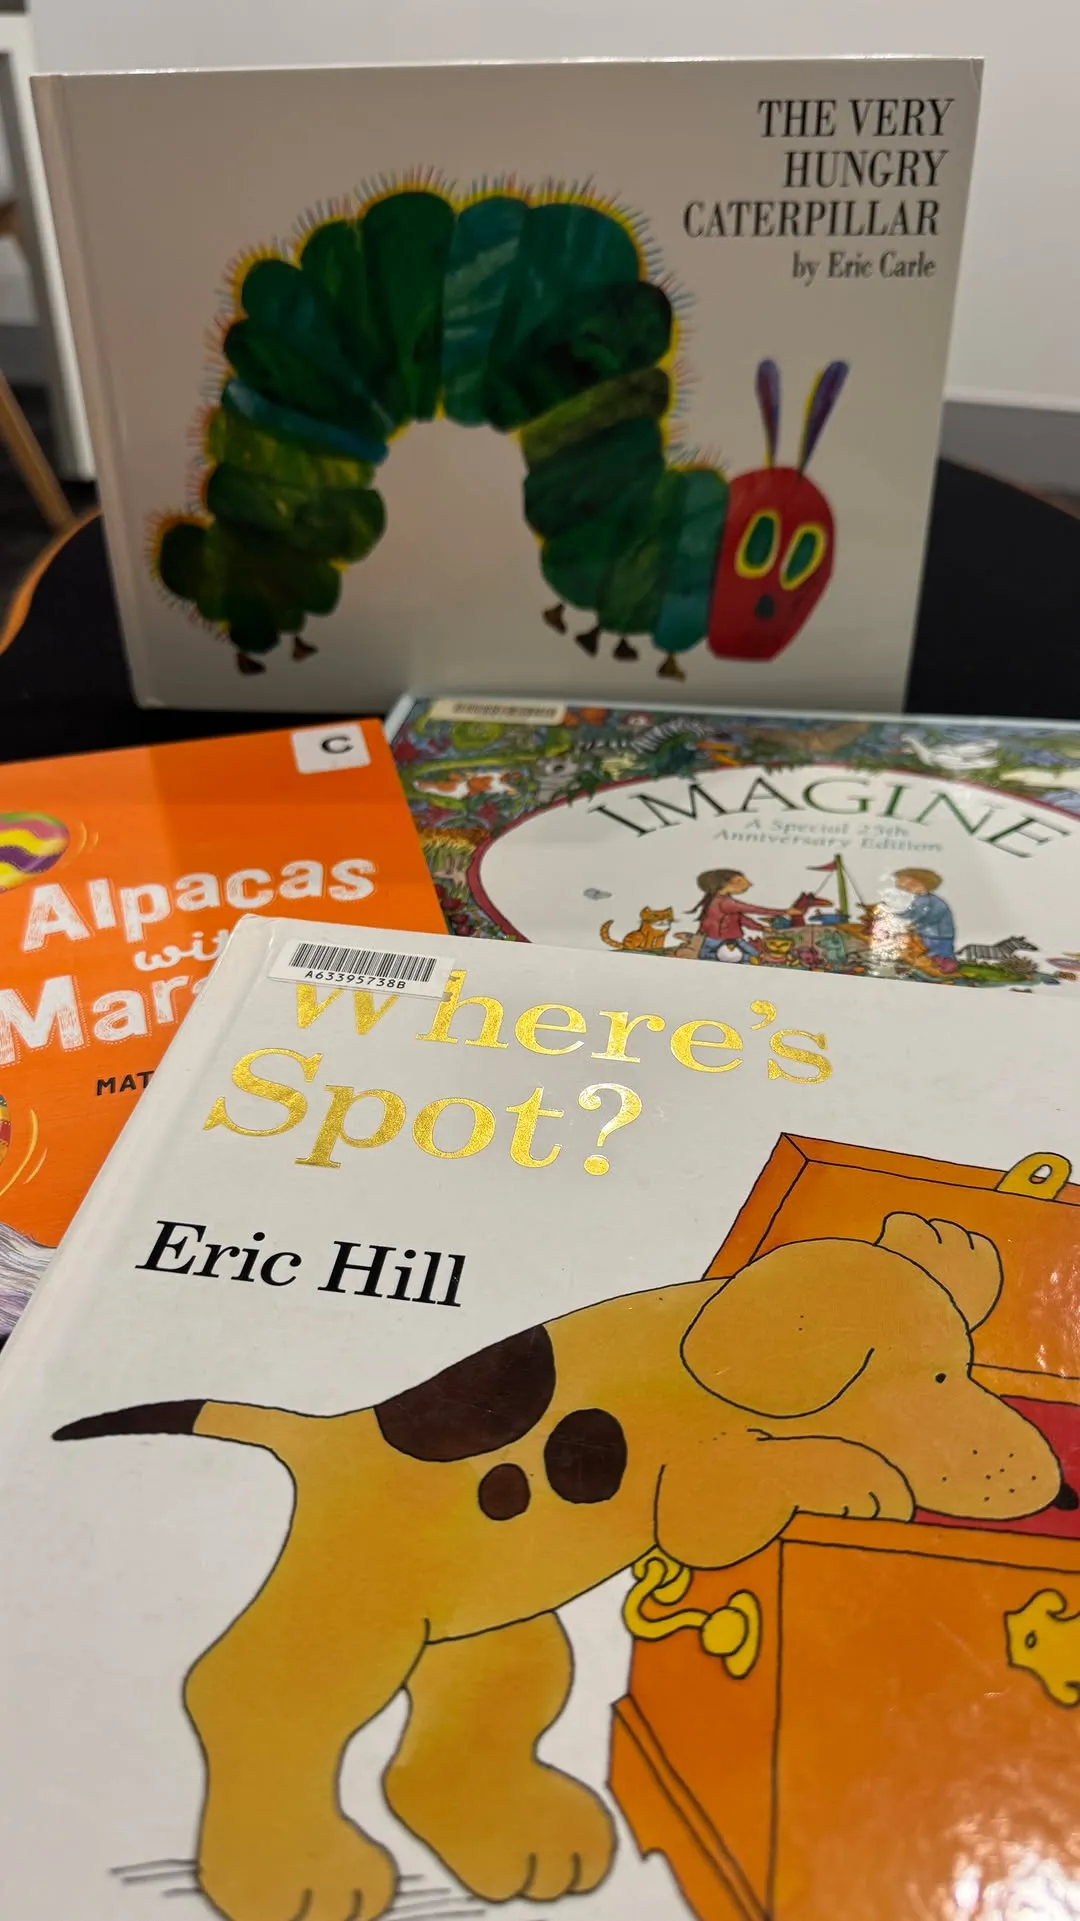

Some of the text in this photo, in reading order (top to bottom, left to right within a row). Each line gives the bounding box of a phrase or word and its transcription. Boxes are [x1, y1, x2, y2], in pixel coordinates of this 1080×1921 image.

[757, 98, 955, 137] THE VERY
[783, 150, 948, 188] HUNGRY
[683, 199, 939, 238] CATERPILLAR
[792, 250, 936, 287] by Eric Carle
[320, 735, 353, 755] C
[589, 776, 1072, 858] IMAGINE
[744, 818, 909, 837] A Special 25th
[714, 828, 943, 851] Anniversary Edition
[21, 858, 377, 952] Alpacas
[304, 970, 407, 989] A63395738B
[0, 974, 209, 1066] Mar
[203, 1047, 643, 1176] Spot?
[135, 1219, 466, 1307] Eric Hill
